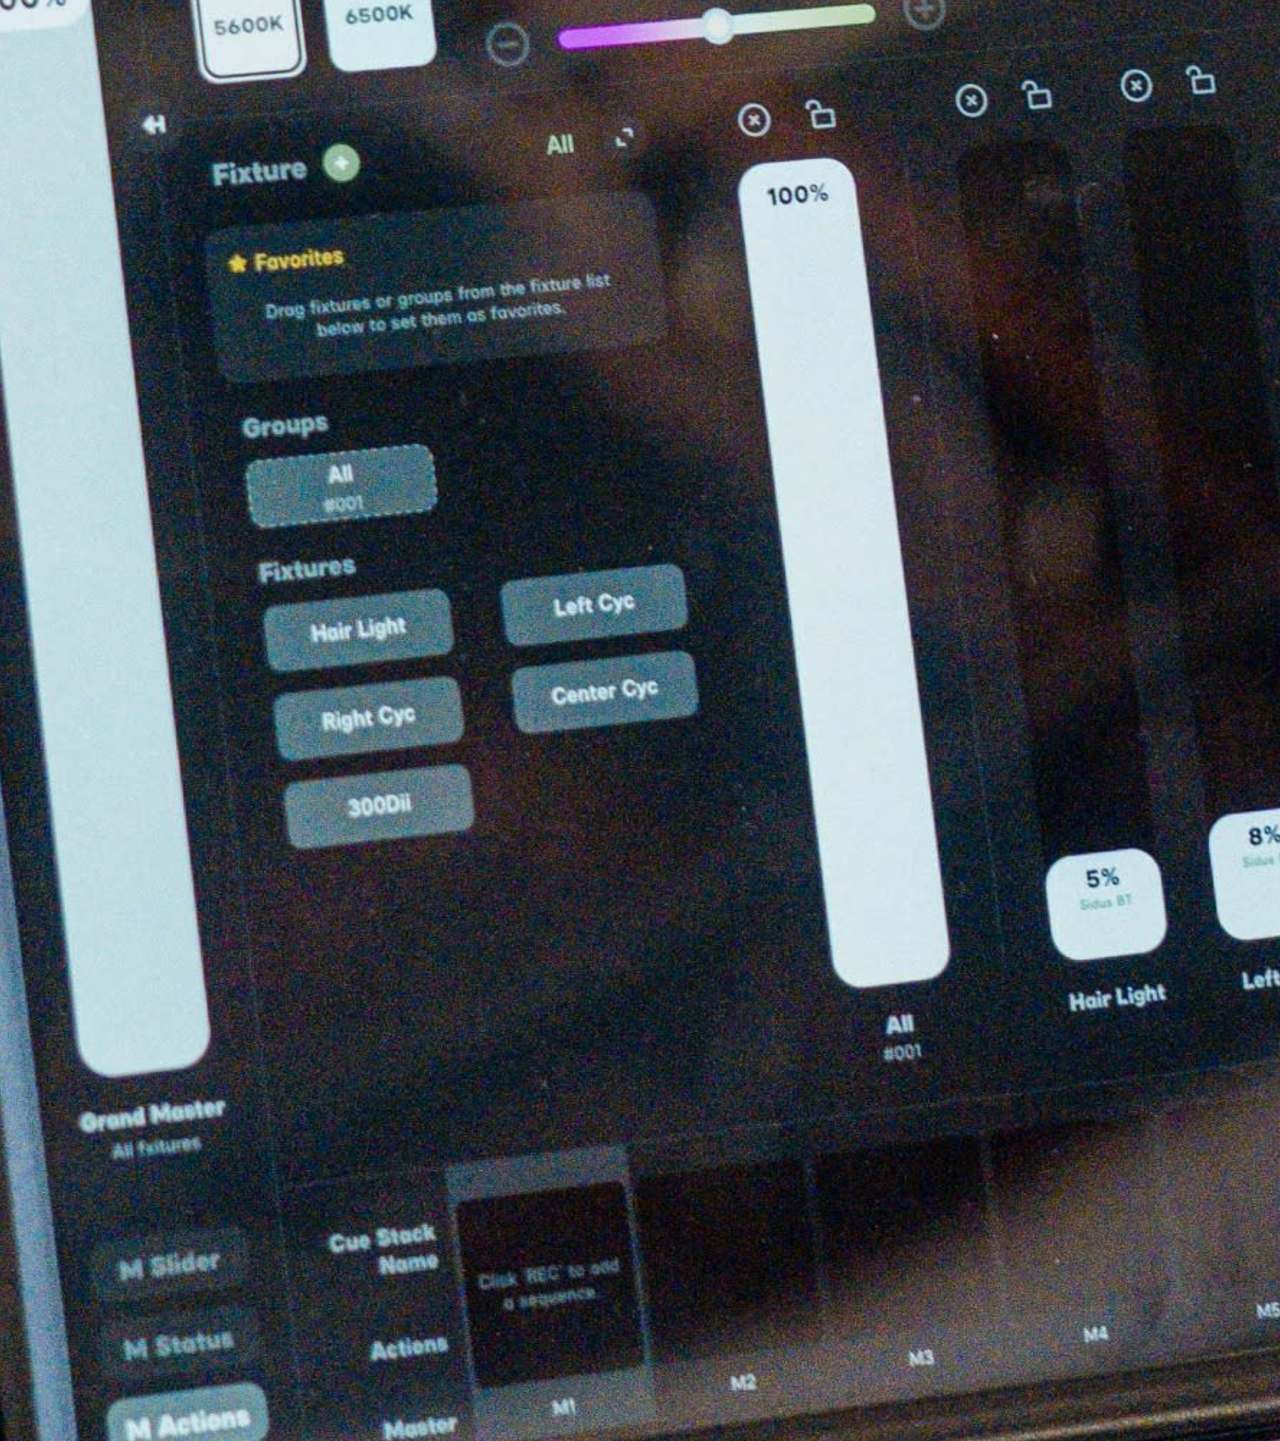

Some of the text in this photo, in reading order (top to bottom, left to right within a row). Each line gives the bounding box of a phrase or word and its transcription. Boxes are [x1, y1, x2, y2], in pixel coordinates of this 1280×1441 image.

[215, 16, 283, 36] 5600K
[345, 5, 413, 24] 6500K
[547, 135, 574, 155] All
[212, 161, 307, 187] Fixture
[767, 183, 828, 206] 100%
[254, 250, 344, 272] Favorites
[266, 273, 610, 322] Drag fixtures or groups from the fixture list
[317, 300, 565, 337] below to set them as favorites.
[243, 414, 328, 438] Groups
[328, 465, 353, 485] All
[323, 496, 363, 514] #001
[259, 557, 356, 583] Fixtures
[554, 593, 636, 617] Left Cyc
[310, 617, 406, 644] Hair Light
[551, 680, 658, 705] Center Cyc
[321, 705, 416, 732] Right Cyc
[348, 794, 411, 817] 300Dii
[1242, 854, 1275, 868] Sidus
[1086, 867, 1120, 888] 5%
[1080, 894, 1132, 911] Sidus BT
[1242, 970, 1280, 990] Left
[1069, 984, 1166, 1012] Hair Light
[886, 1014, 914, 1036] All
[883, 1043, 921, 1061] #001
[79, 1098, 226, 1133] Grand Master
[329, 1222, 437, 1254] Cue Stack
[118, 1251, 220, 1281] M Slider
[379, 1253, 439, 1277] Name
[568, 1265, 585, 1278] to
[591, 1257, 620, 1275] add
[503, 1297, 514, 1311] a
[123, 1330, 234, 1361] M Status
[1083, 1325, 1109, 1344] M4
[370, 1335, 448, 1362] Actions
[908, 1350, 935, 1367] M3
[731, 1374, 757, 1392] M2
[552, 1399, 575, 1418] M1
[125, 1408, 251, 1441] M Actions
[383, 1417, 458, 1441] Master
